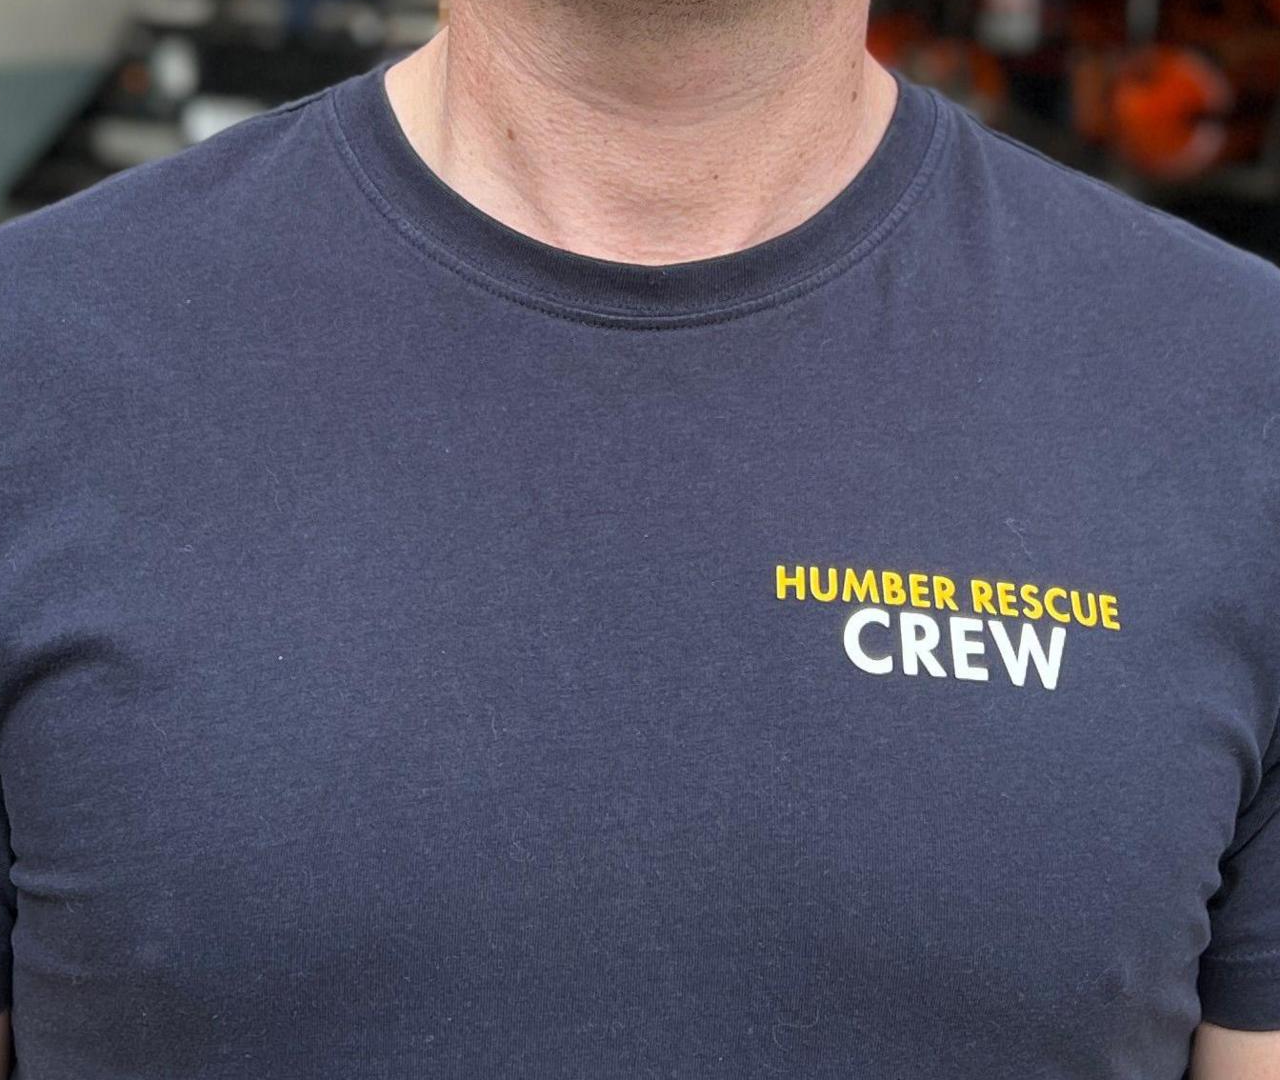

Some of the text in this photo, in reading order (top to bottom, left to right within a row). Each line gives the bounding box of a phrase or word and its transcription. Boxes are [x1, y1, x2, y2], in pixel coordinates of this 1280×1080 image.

[775, 565, 1121, 631] HUMBER RESCUE
[843, 607, 1067, 690] CREW
